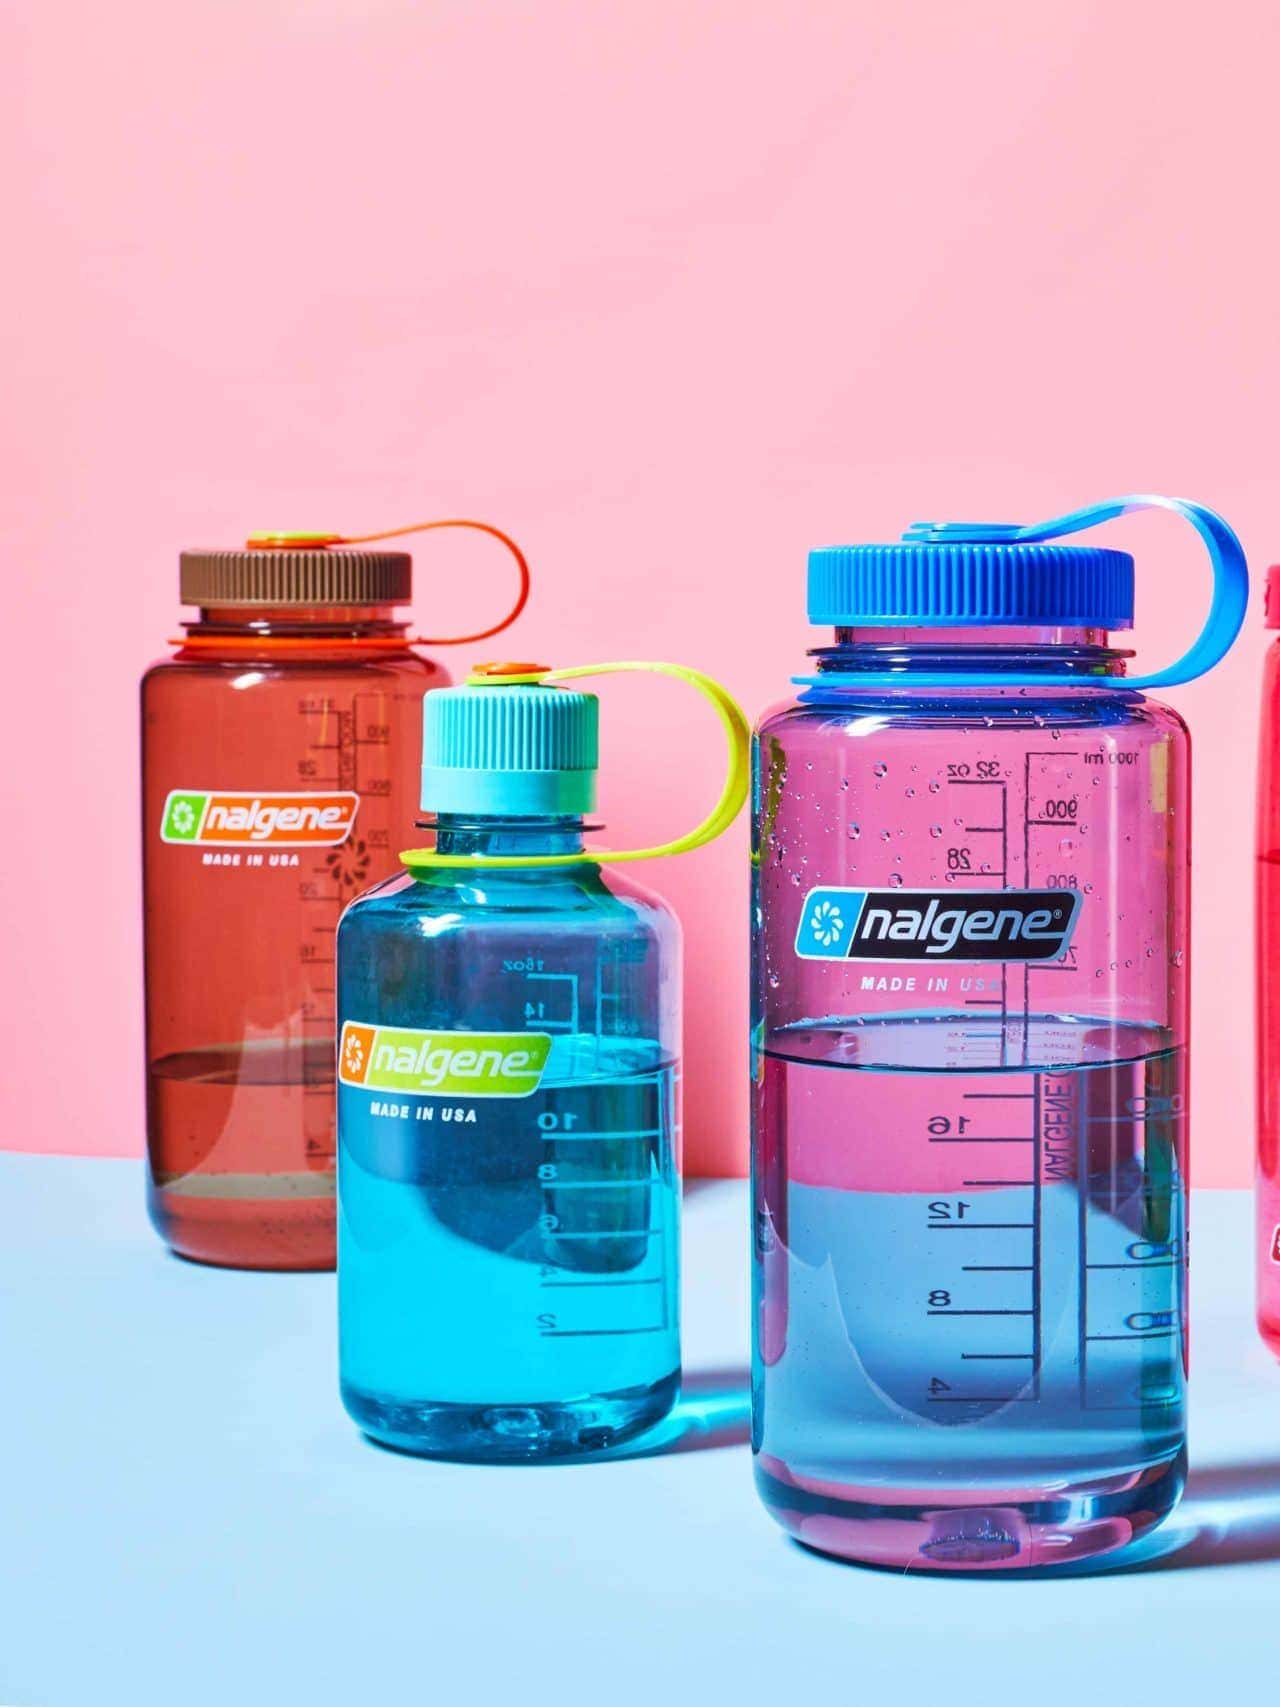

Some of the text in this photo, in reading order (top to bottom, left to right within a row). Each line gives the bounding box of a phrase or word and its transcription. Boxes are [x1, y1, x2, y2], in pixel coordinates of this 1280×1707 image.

[206, 799, 351, 840] nalgene
[202, 853, 300, 867] MADE IN USA
[860, 976, 917, 992] MADE
[927, 977, 948, 992] IN
[373, 1038, 542, 1087] nalgene
[369, 1101, 477, 1122] MADE IN USA
